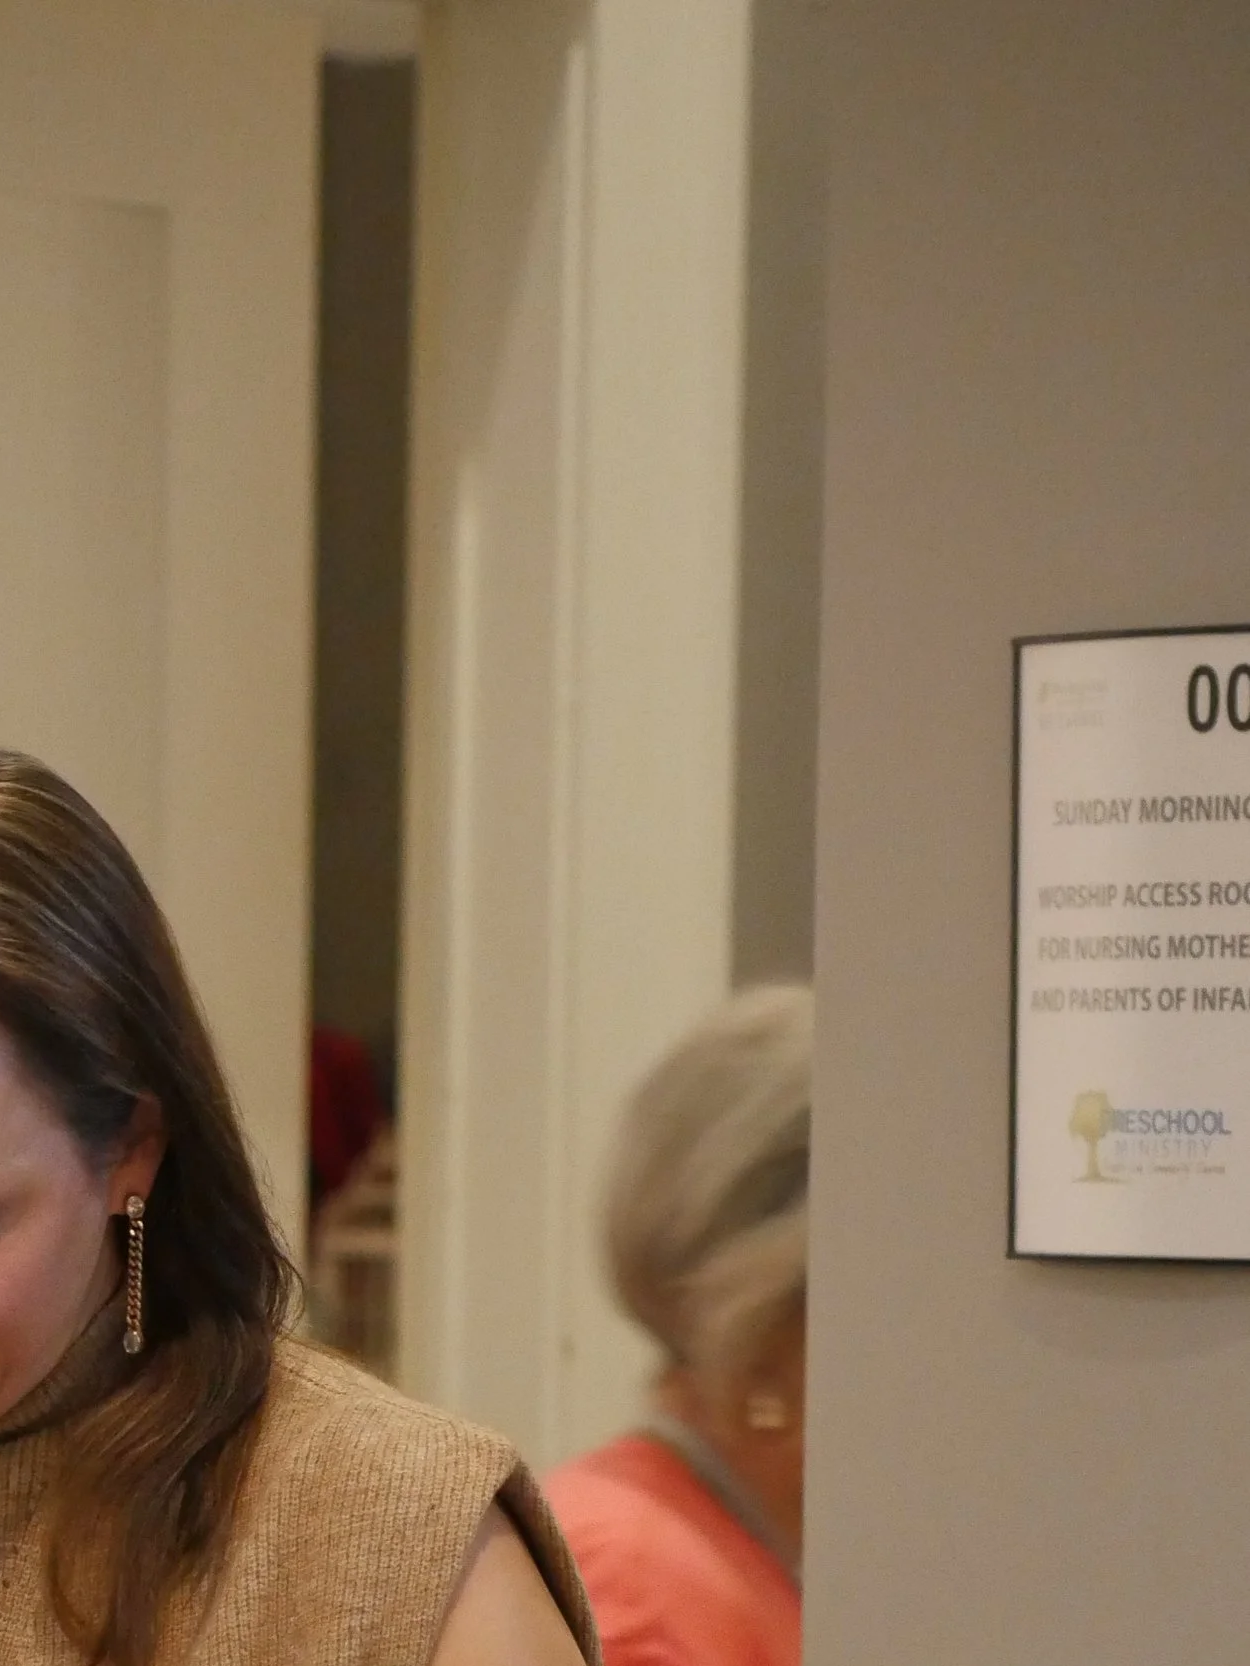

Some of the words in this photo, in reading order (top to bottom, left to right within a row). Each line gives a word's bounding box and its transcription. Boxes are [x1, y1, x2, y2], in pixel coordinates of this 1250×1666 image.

[1053, 799, 1133, 825] SUNDAY
[1039, 884, 1118, 909] WORSHIP
[1124, 882, 1201, 907] ACCESS
[1039, 936, 1070, 960] FOR
[1075, 935, 1161, 960] NURSING
[1031, 990, 1065, 1012] AND
[1070, 987, 1151, 1012] PARENTS
[1157, 987, 1186, 1011] OF
[1193, 986, 1250, 1011] INFA
